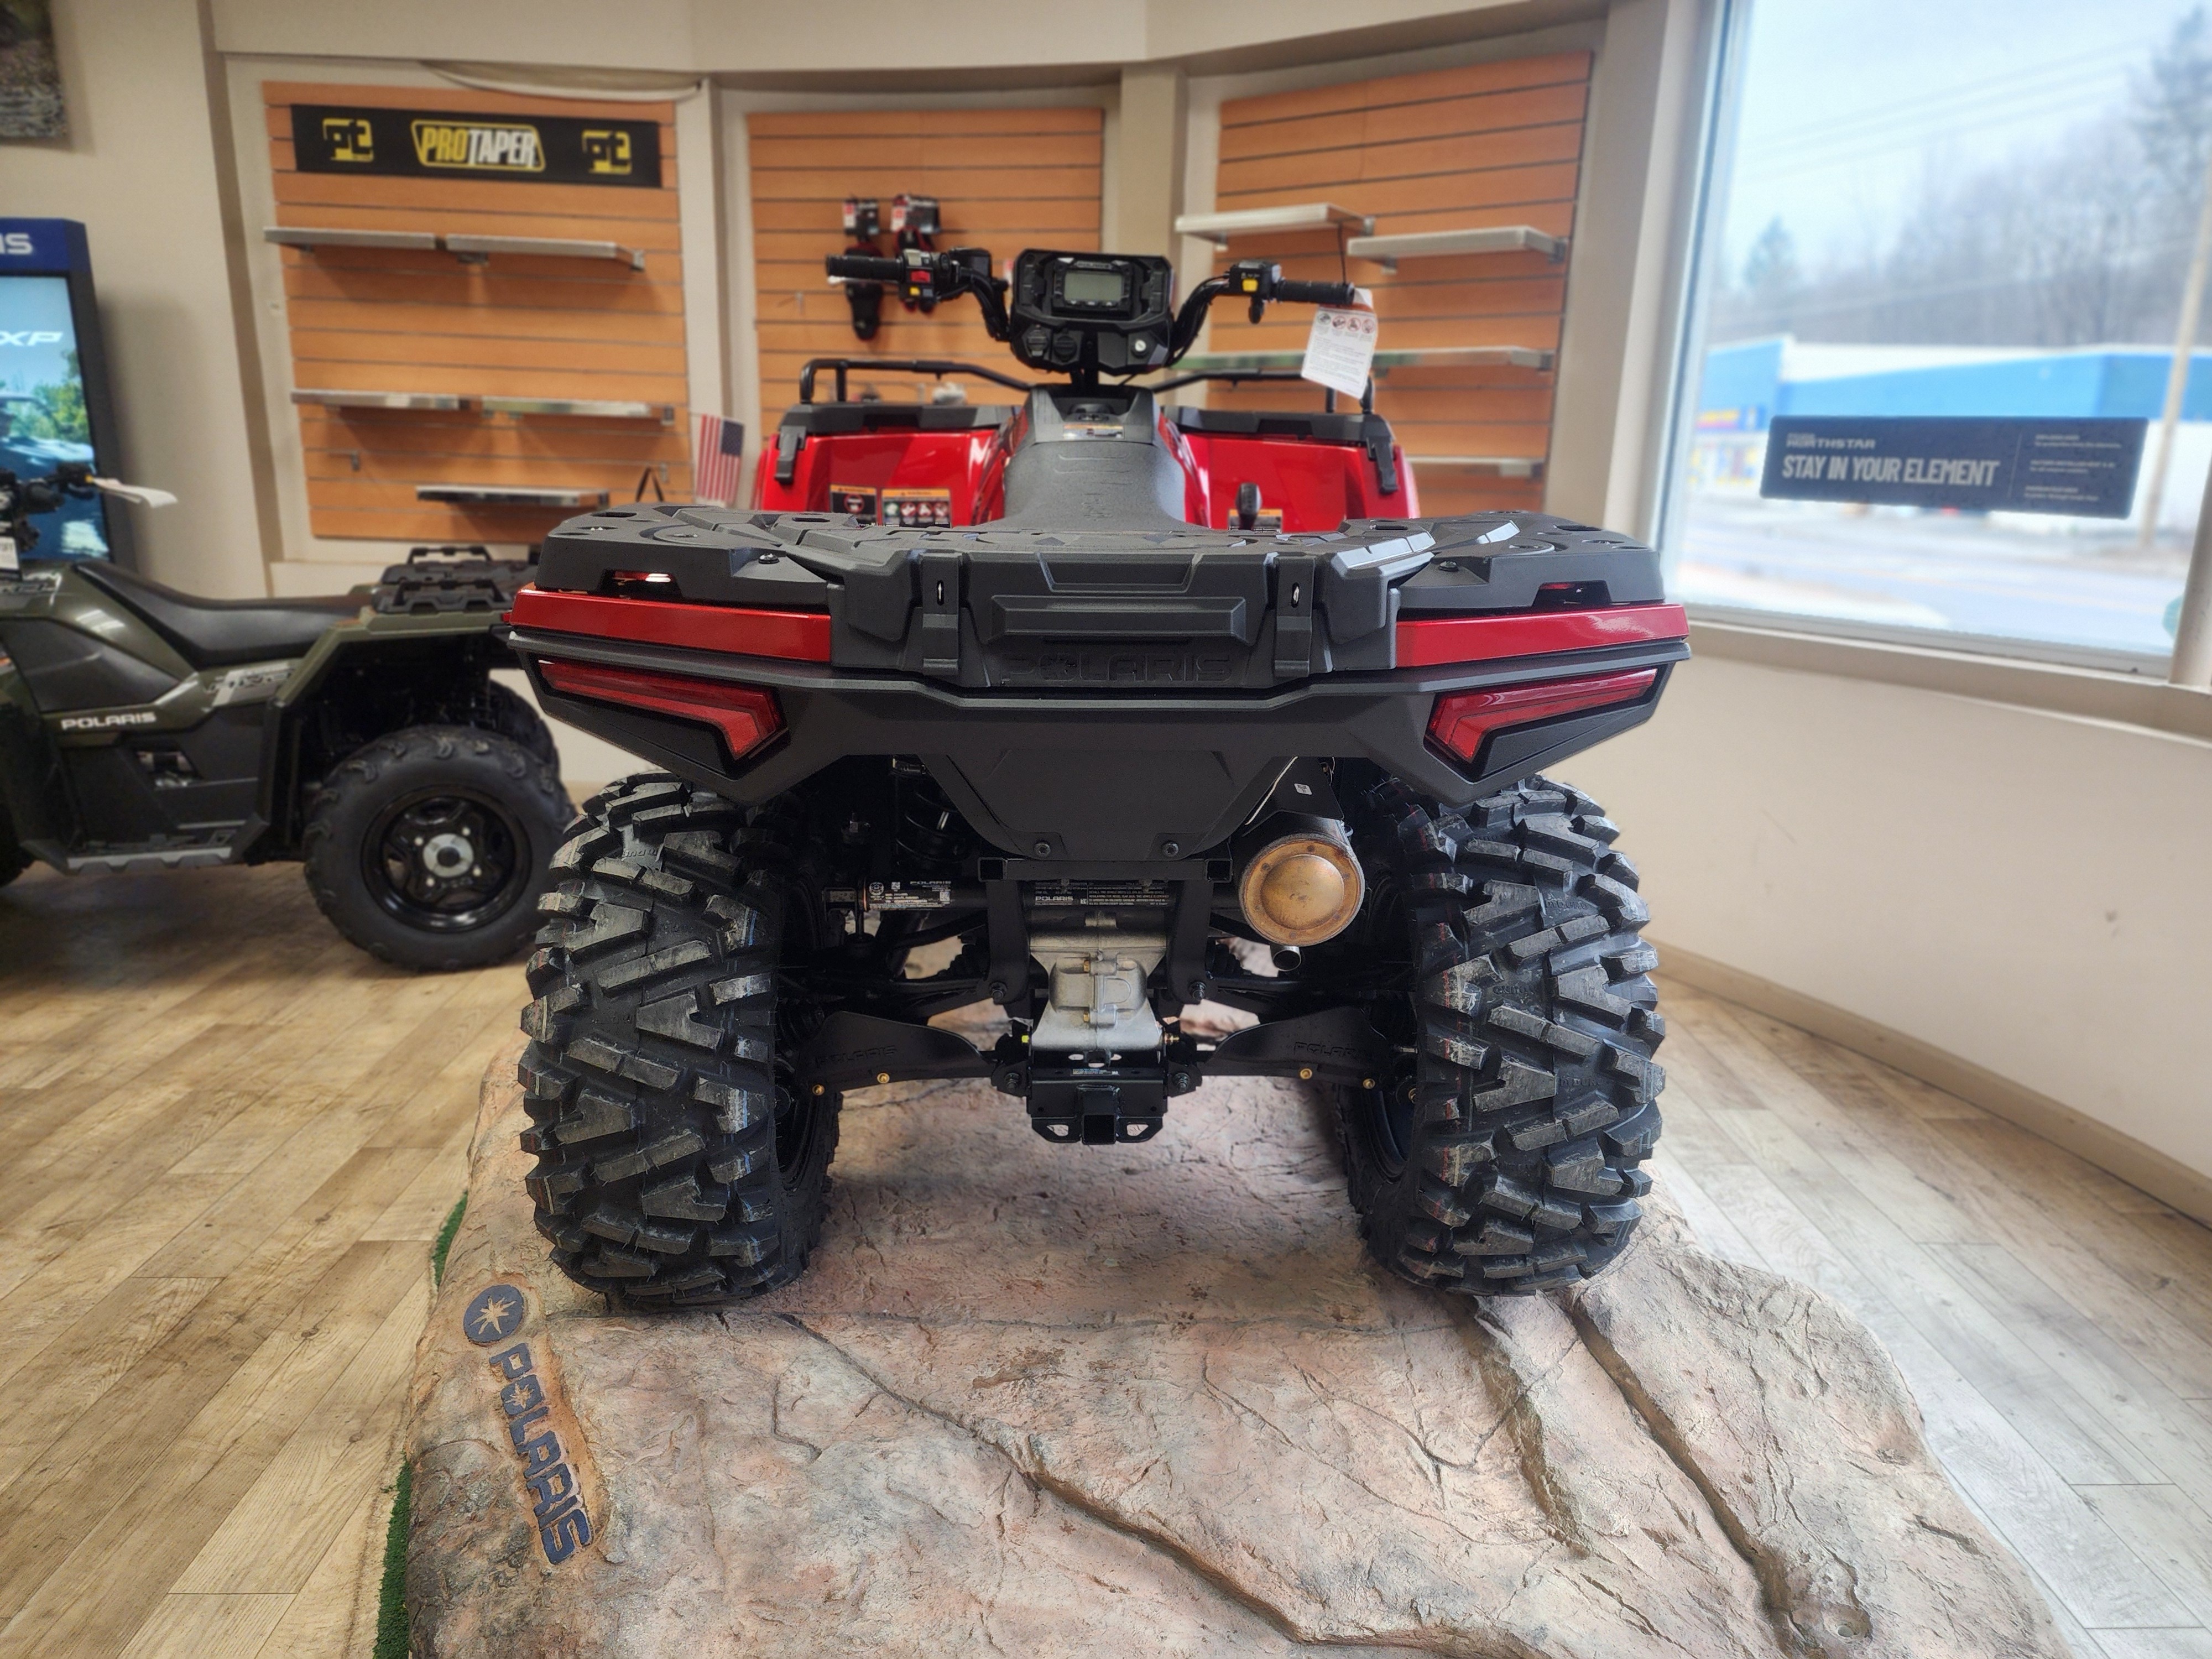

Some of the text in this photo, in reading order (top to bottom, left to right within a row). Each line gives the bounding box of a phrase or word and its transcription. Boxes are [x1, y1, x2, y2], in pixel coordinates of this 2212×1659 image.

[420, 126, 538, 169] PROTAPER
[1782, 455, 2001, 487] STAY IN YOUR ELEMENT
[1000, 653, 1232, 682] POLARIS
[61, 711, 156, 731] POLARIS
[489, 1342, 591, 1566] POLARIS
